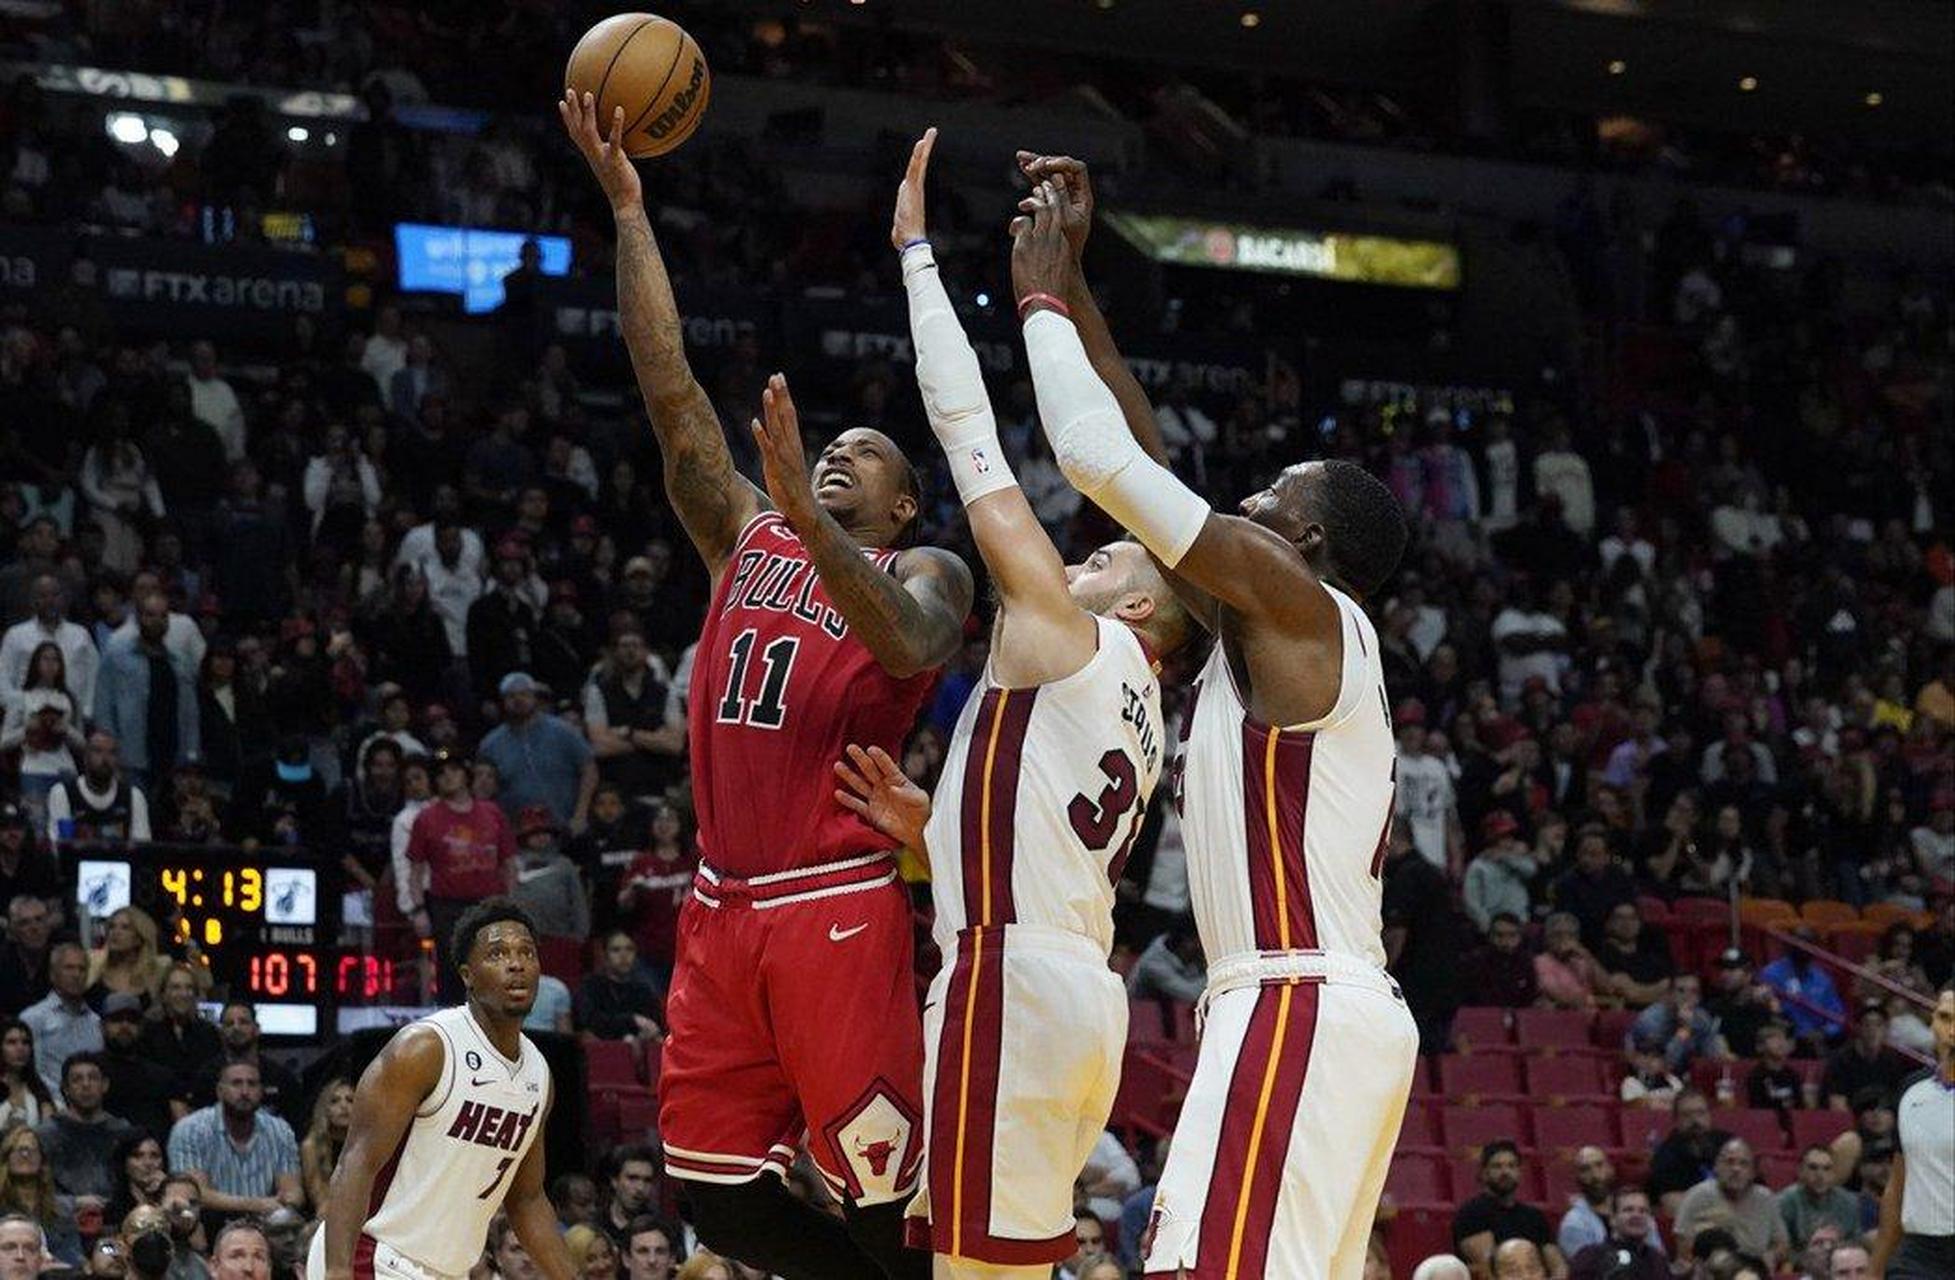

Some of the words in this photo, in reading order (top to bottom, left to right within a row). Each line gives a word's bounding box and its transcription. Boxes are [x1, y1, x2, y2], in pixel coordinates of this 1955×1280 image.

[644, 57, 703, 138] Wilson
[716, 628, 801, 731] 11
[160, 867, 263, 913] 4:13
[251, 953, 317, 996] 107
[447, 1100, 540, 1152] HEAT
[478, 1157, 516, 1200] 7
